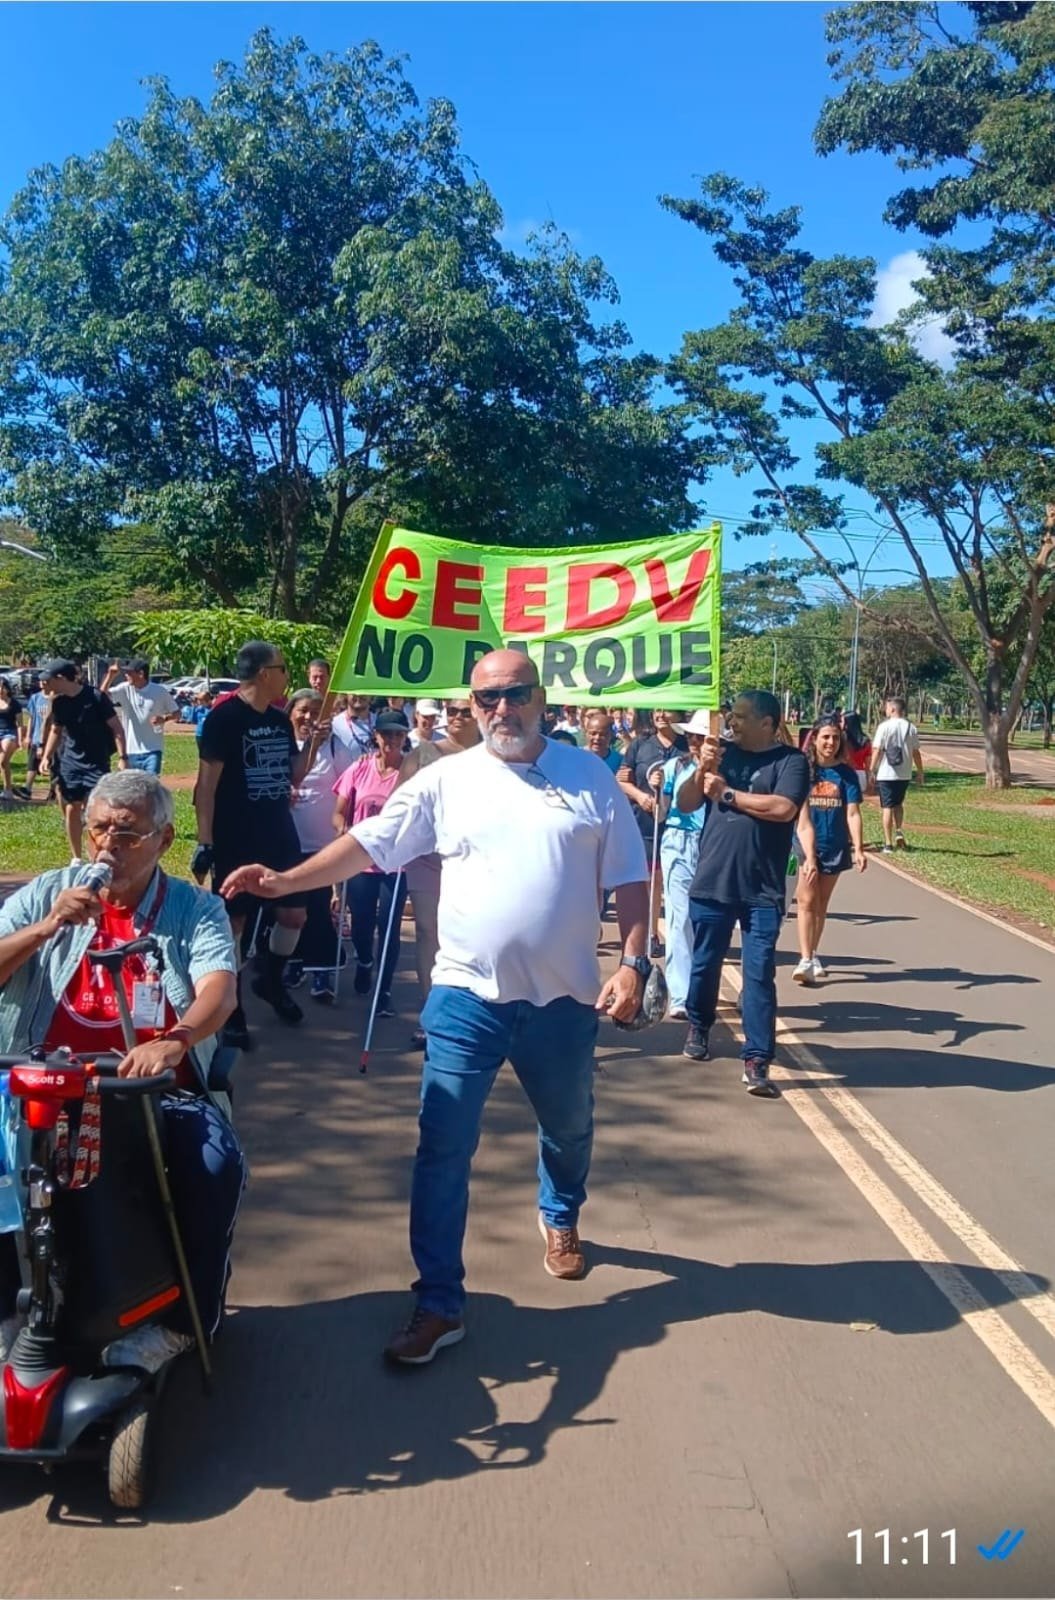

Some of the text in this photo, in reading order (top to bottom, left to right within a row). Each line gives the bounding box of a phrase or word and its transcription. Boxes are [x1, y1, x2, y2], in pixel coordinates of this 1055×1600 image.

[372, 547, 712, 632] CEEDV
[354, 624, 713, 696] NO PRQUE
[55, 1075, 65, 1086] S
